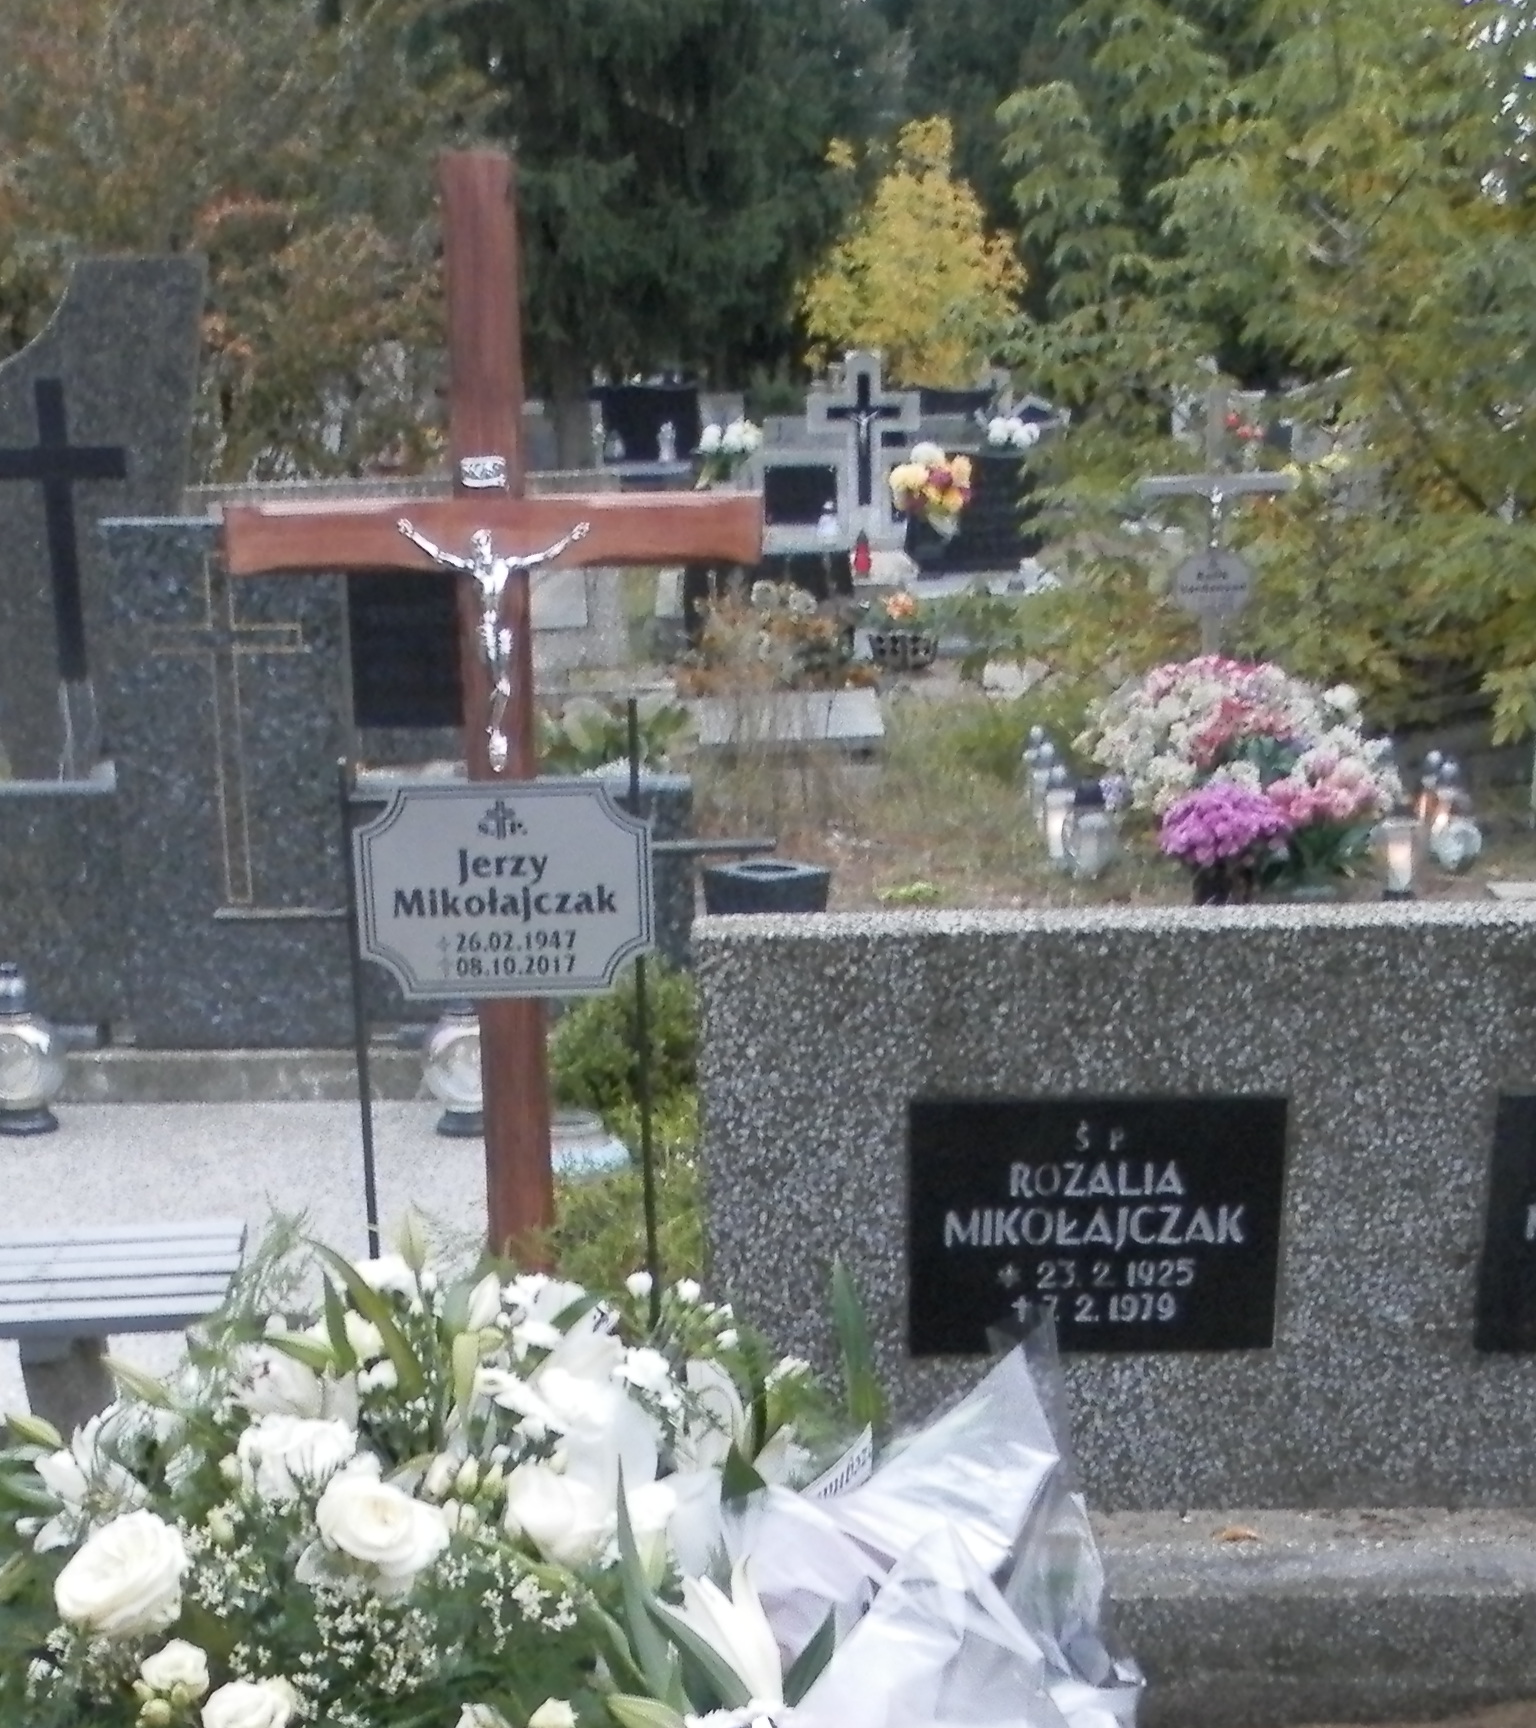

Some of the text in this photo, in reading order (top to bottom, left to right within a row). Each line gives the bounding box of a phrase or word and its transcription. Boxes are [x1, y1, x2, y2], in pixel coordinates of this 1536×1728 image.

[459, 848, 548, 887] Jerzy
[393, 882, 617, 923] Mikołajczak
[456, 929, 577, 953] 26.02.1947
[456, 953, 576, 978] 08.10.2017
[1009, 1159, 1186, 1199] ROZALIA
[943, 1203, 1246, 1253] MIKOŁAJCZAK
[1107, 1290, 1177, 1323] 1979
